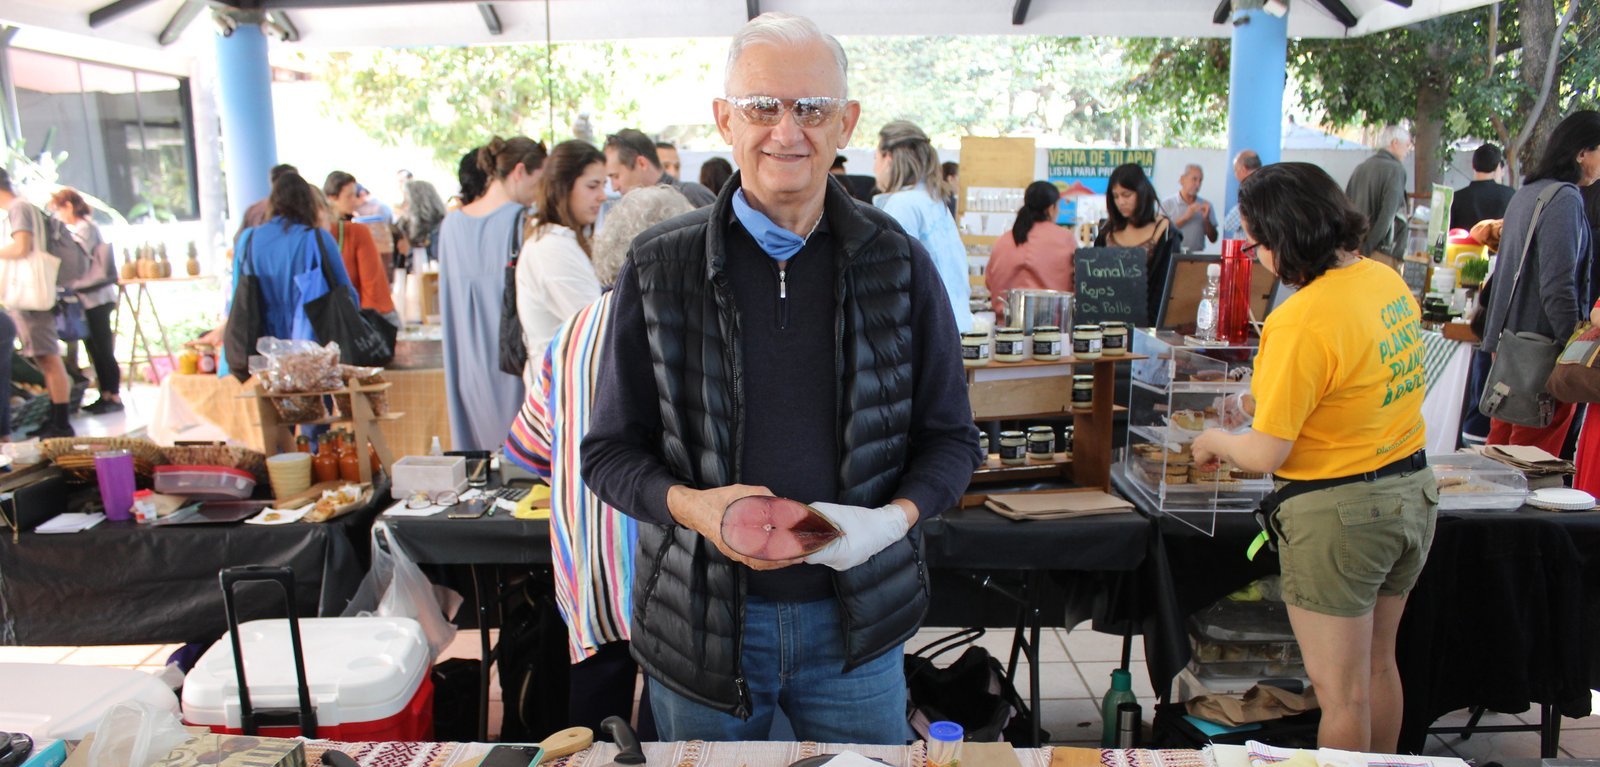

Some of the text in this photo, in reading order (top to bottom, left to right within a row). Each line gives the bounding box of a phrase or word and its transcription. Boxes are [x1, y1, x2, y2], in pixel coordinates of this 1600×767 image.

[1049, 149, 1153, 166] VENTA DE TILAPIA
[1049, 166, 1072, 177] LISTA
[1074, 166, 1097, 177] PARA
[1080, 259, 1142, 278] Tamales
[1081, 281, 1115, 299] Rojos
[1381, 295, 1413, 330] COME
